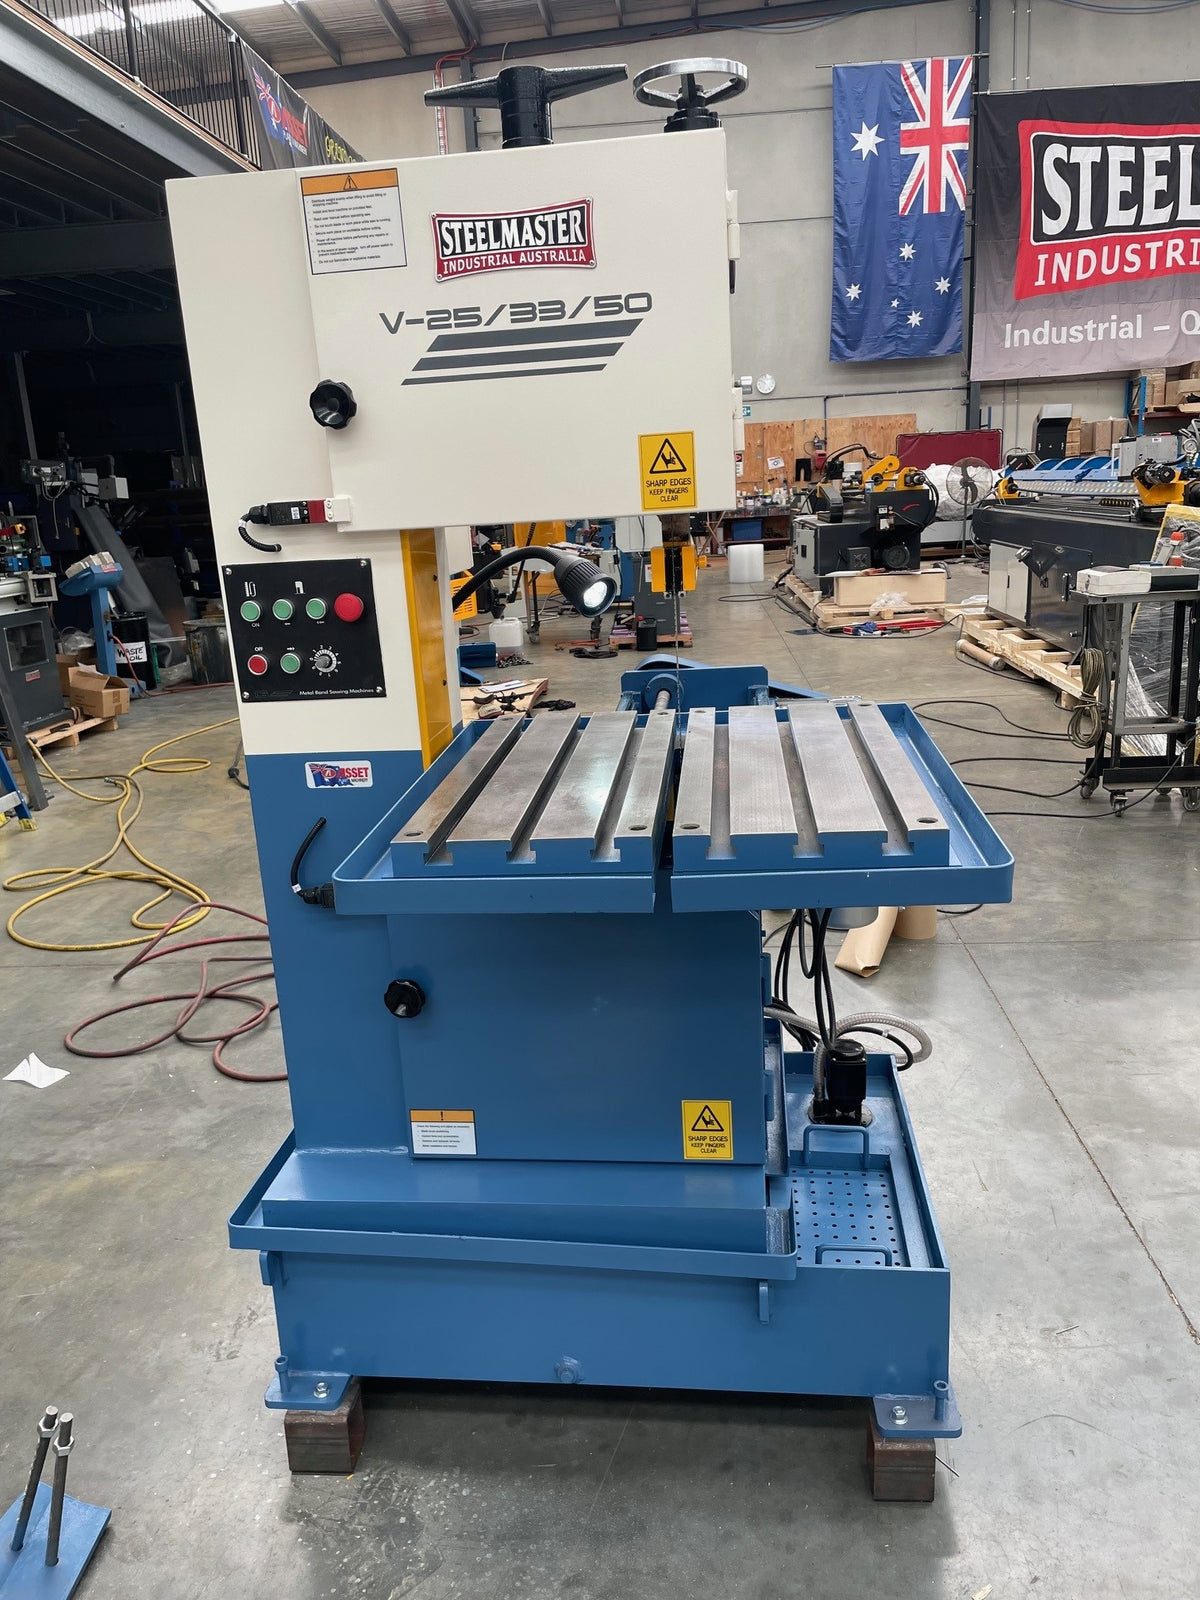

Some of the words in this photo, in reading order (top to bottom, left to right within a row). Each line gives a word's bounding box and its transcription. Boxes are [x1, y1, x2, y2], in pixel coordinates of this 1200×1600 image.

[1042, 143, 1200, 236] STEEL
[441, 209, 585, 256] STEELMASTER
[443, 253, 515, 275] INDUSTRIAL
[519, 249, 587, 263] AUSTRALIA
[1034, 238, 1200, 287] INDUSTRI
[378, 292, 653, 335] V-25/33/50
[1004, 314, 1142, 348] Industrial
[645, 480, 668, 488] SHARP
[669, 478, 692, 487] EDGES
[665, 486, 689, 495] FINGERS
[660, 494, 679, 503] CLEAR
[117, 646, 144, 658] WASTE
[329, 688, 349, 696] Sawing
